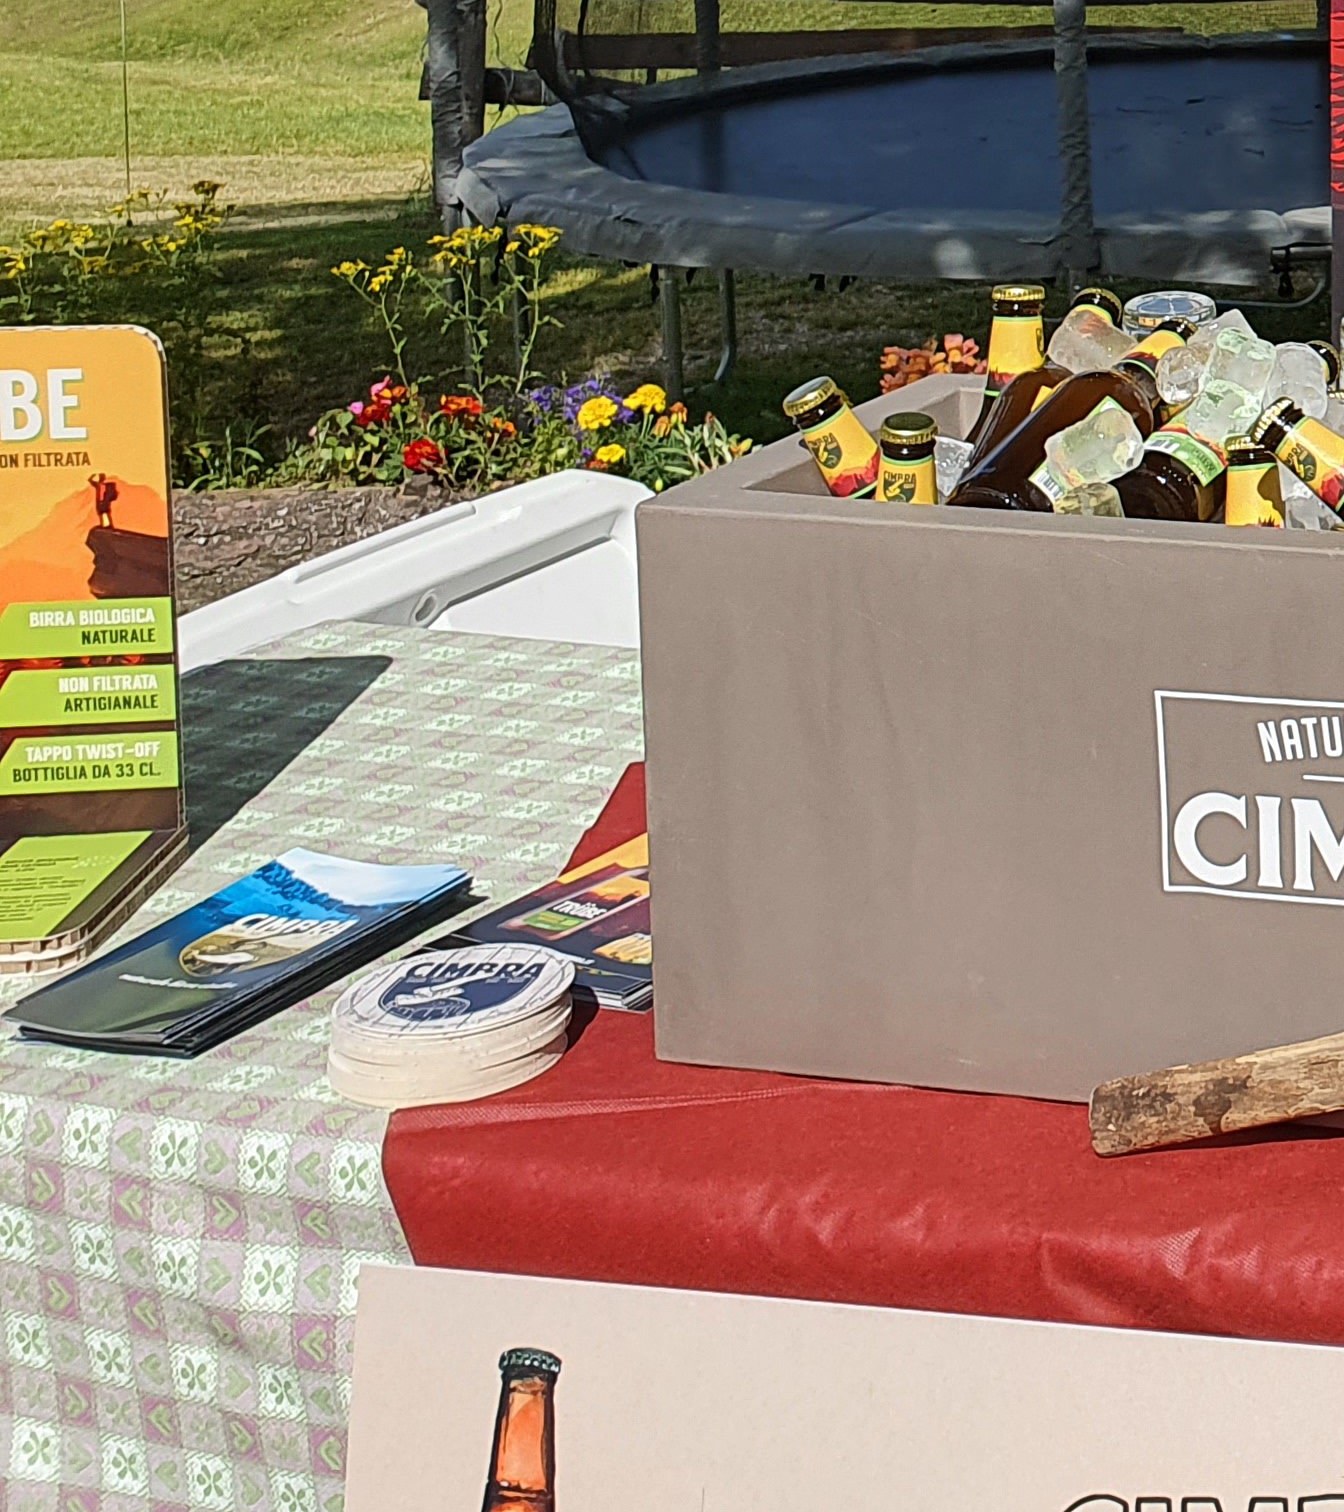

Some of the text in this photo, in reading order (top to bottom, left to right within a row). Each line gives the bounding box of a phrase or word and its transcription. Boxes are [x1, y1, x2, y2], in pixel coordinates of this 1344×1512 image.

[24, 451, 91, 468] FILTRATA
[29, 607, 156, 628] BIRRA BIOLOGICA
[81, 628, 156, 645] NATURALE
[58, 674, 158, 693] NON FILTRATA
[64, 694, 159, 712] ARTIGIANALE
[26, 741, 160, 763] TAPPO TWIST-OFF
[13, 761, 161, 783] BOTTIGLIA DA 33 CL.
[233, 913, 358, 936] CIMBRA
[405, 962, 545, 980] CIMBRA
